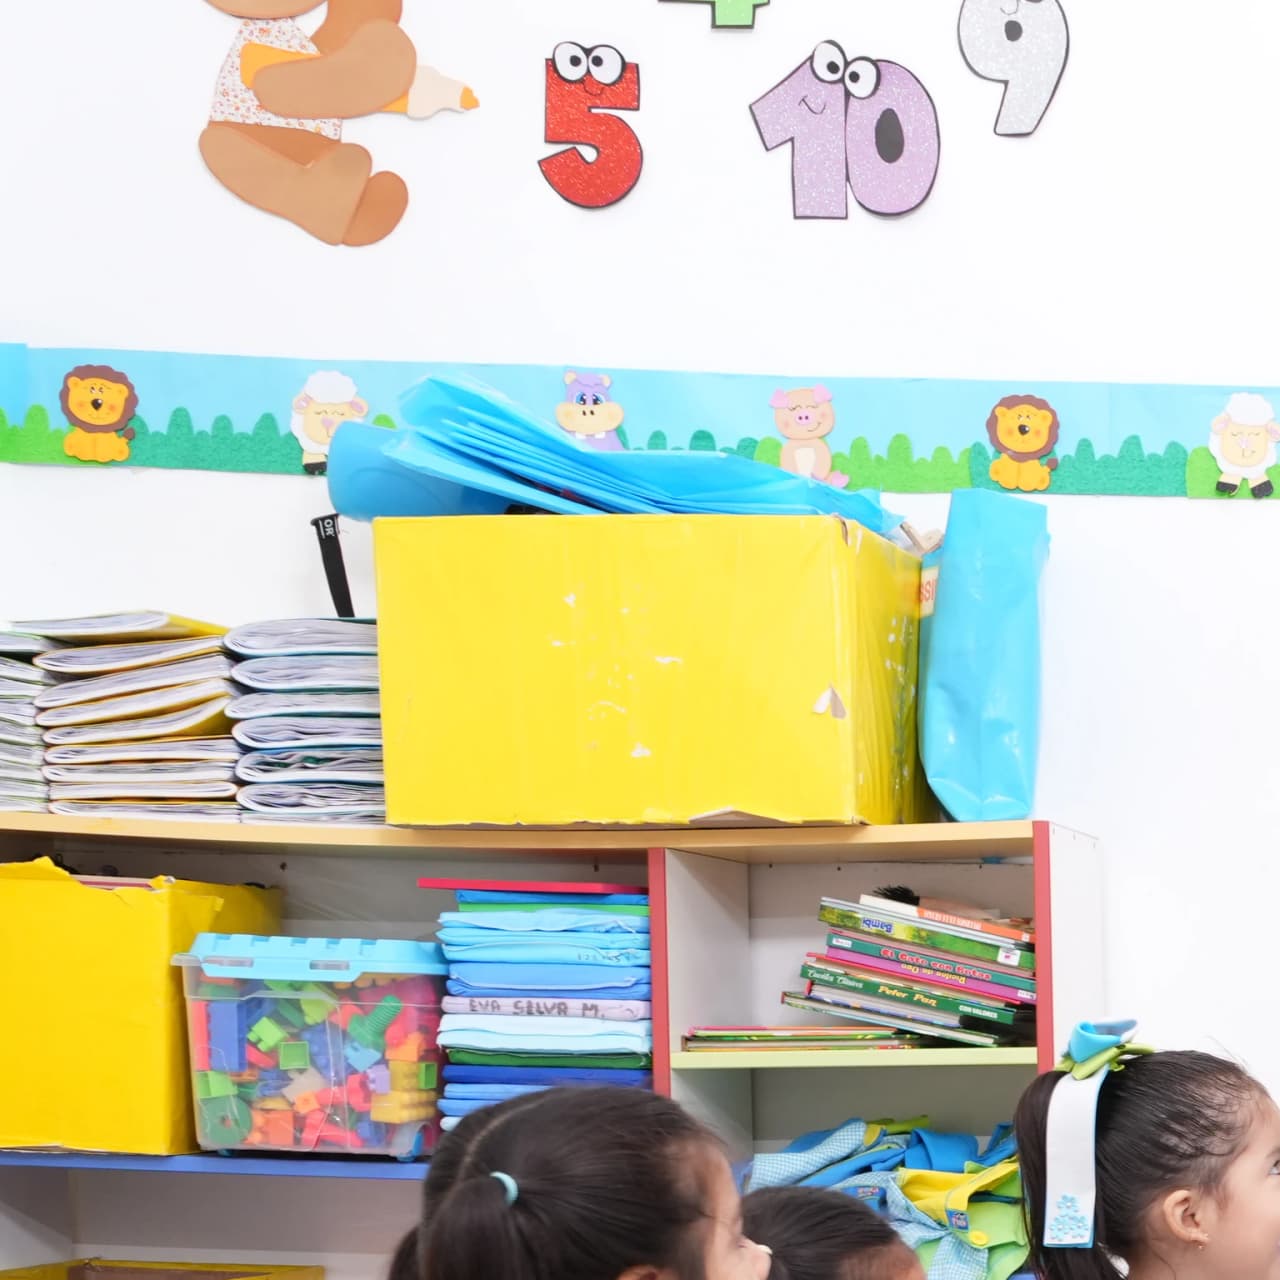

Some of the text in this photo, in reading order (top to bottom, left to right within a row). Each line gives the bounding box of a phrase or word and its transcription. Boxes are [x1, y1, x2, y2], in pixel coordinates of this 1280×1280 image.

[957, 0, 1070, 136] 9
[538, 50, 643, 209] 5
[749, 46, 940, 219] 10
[861, 916, 894, 934] Bambi
[468, 998, 502, 1013] EVA
[878, 985, 909, 1001] Peter
[912, 991, 939, 1009] Pan
